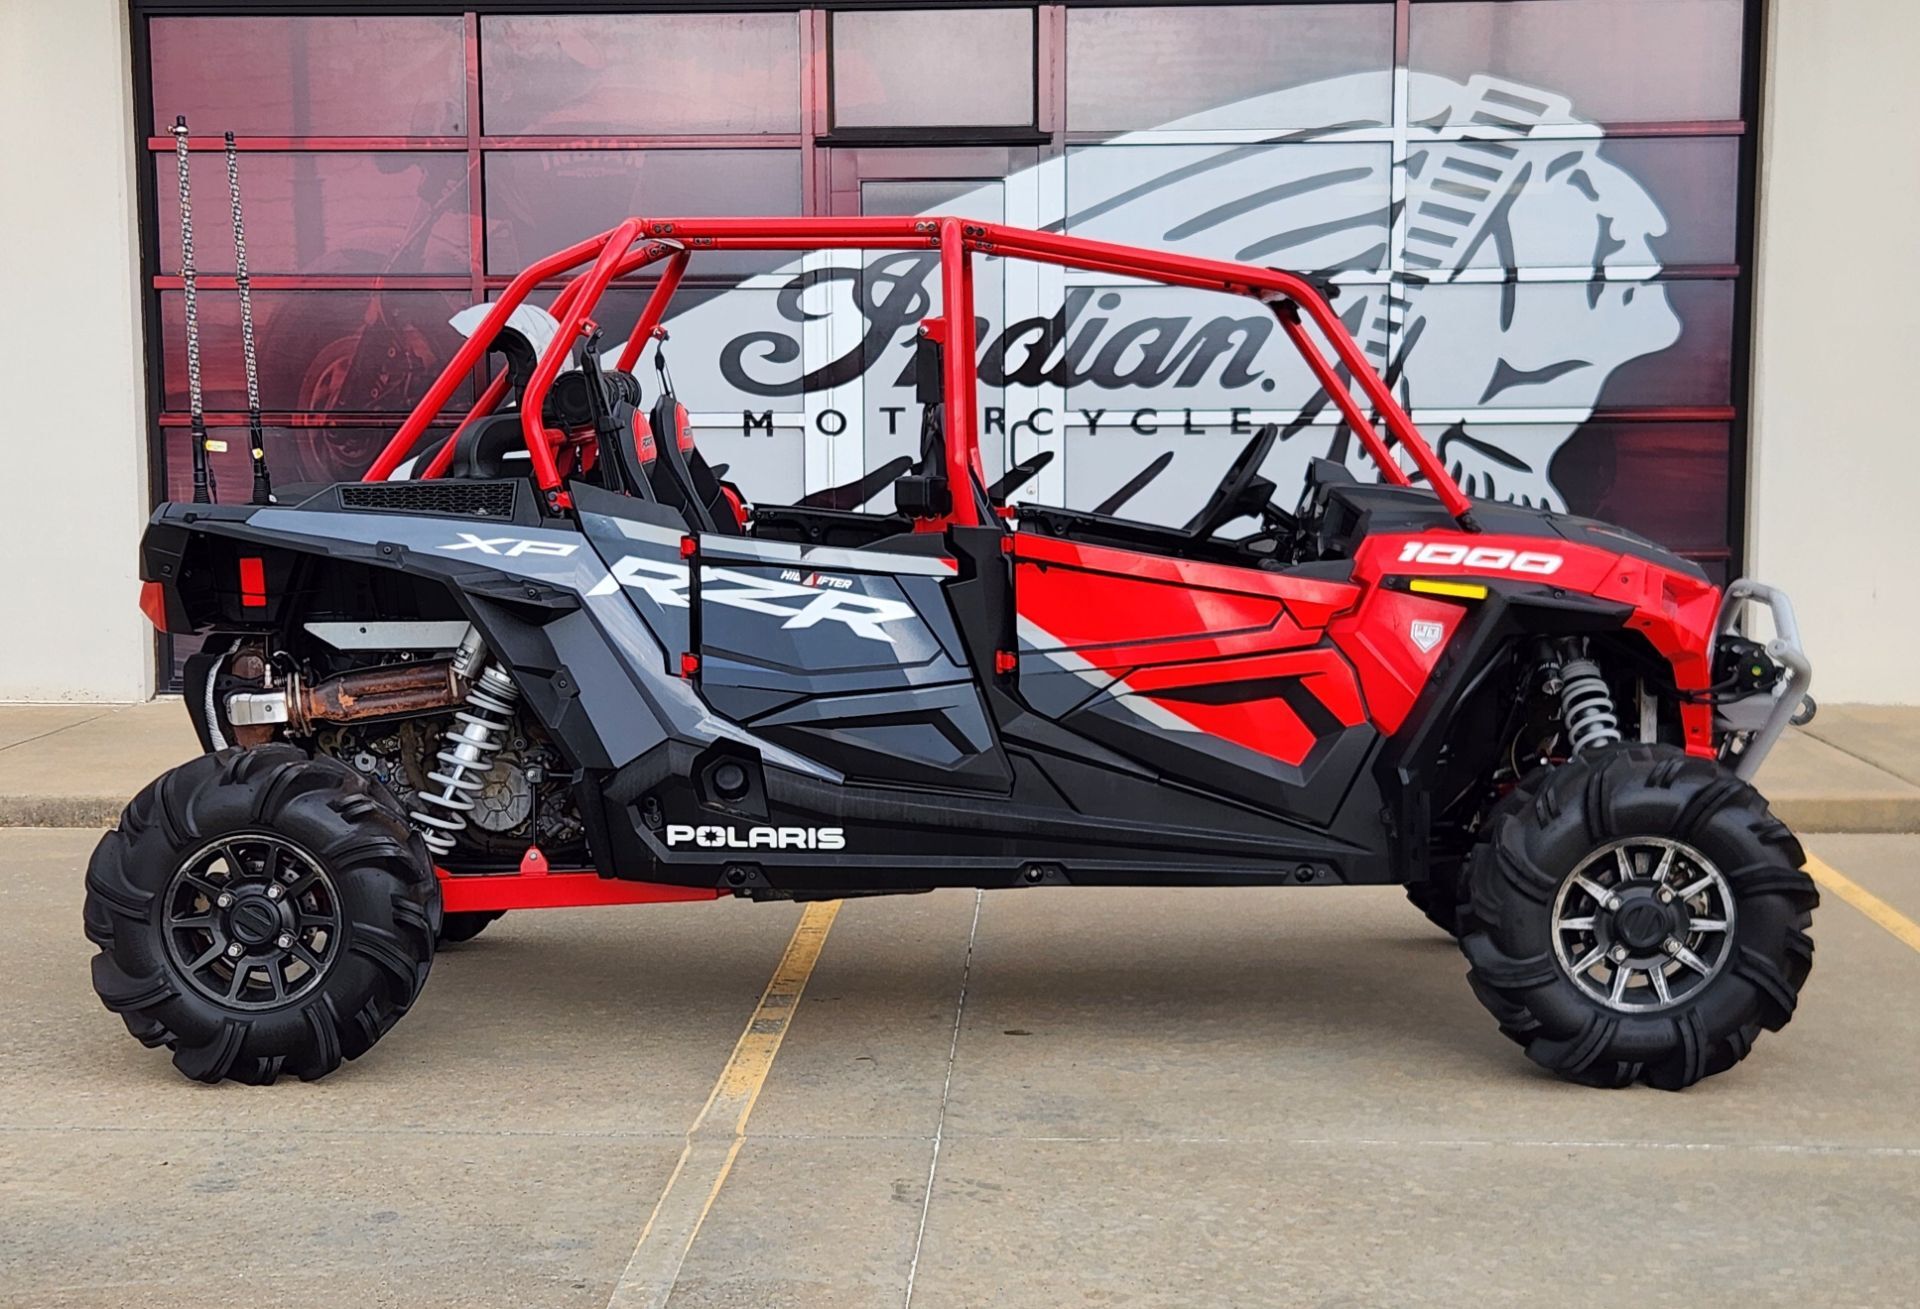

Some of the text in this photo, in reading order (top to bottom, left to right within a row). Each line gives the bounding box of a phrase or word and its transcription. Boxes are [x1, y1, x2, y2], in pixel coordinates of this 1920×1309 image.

[743, 406, 1252, 437] MOTRCYCLE
[437, 532, 580, 557] XP
[1397, 540, 1564, 575] 1000
[586, 555, 918, 643] RZR
[666, 824, 846, 850] POLARIS
